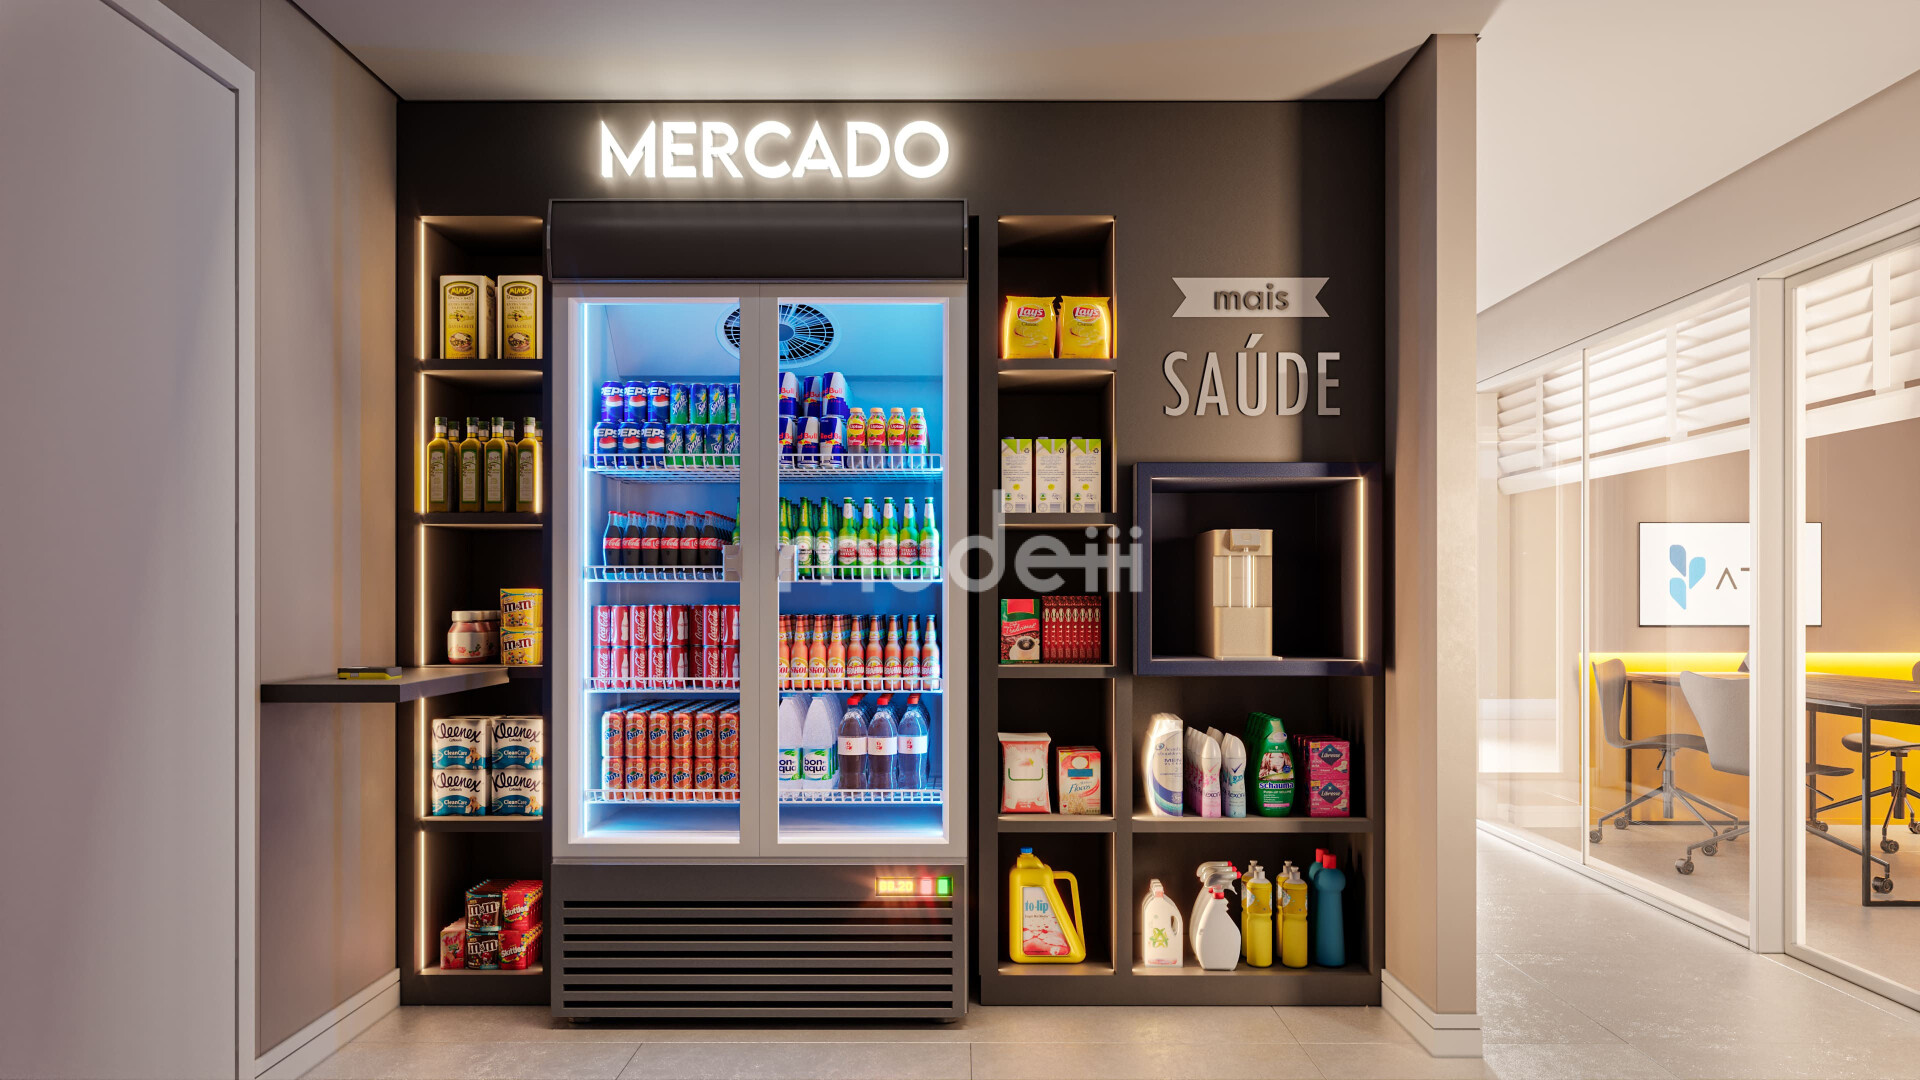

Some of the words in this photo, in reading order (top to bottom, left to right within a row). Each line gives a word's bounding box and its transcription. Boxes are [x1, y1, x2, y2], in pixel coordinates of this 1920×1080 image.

[601, 120, 949, 178] MERCADO
[1214, 283, 1289, 310] mais
[1163, 333, 1341, 416] SAÚDE
[1716, 567, 1750, 590] A
[492, 723, 540, 743] Kleenex
[492, 772, 540, 792] Kleenex
